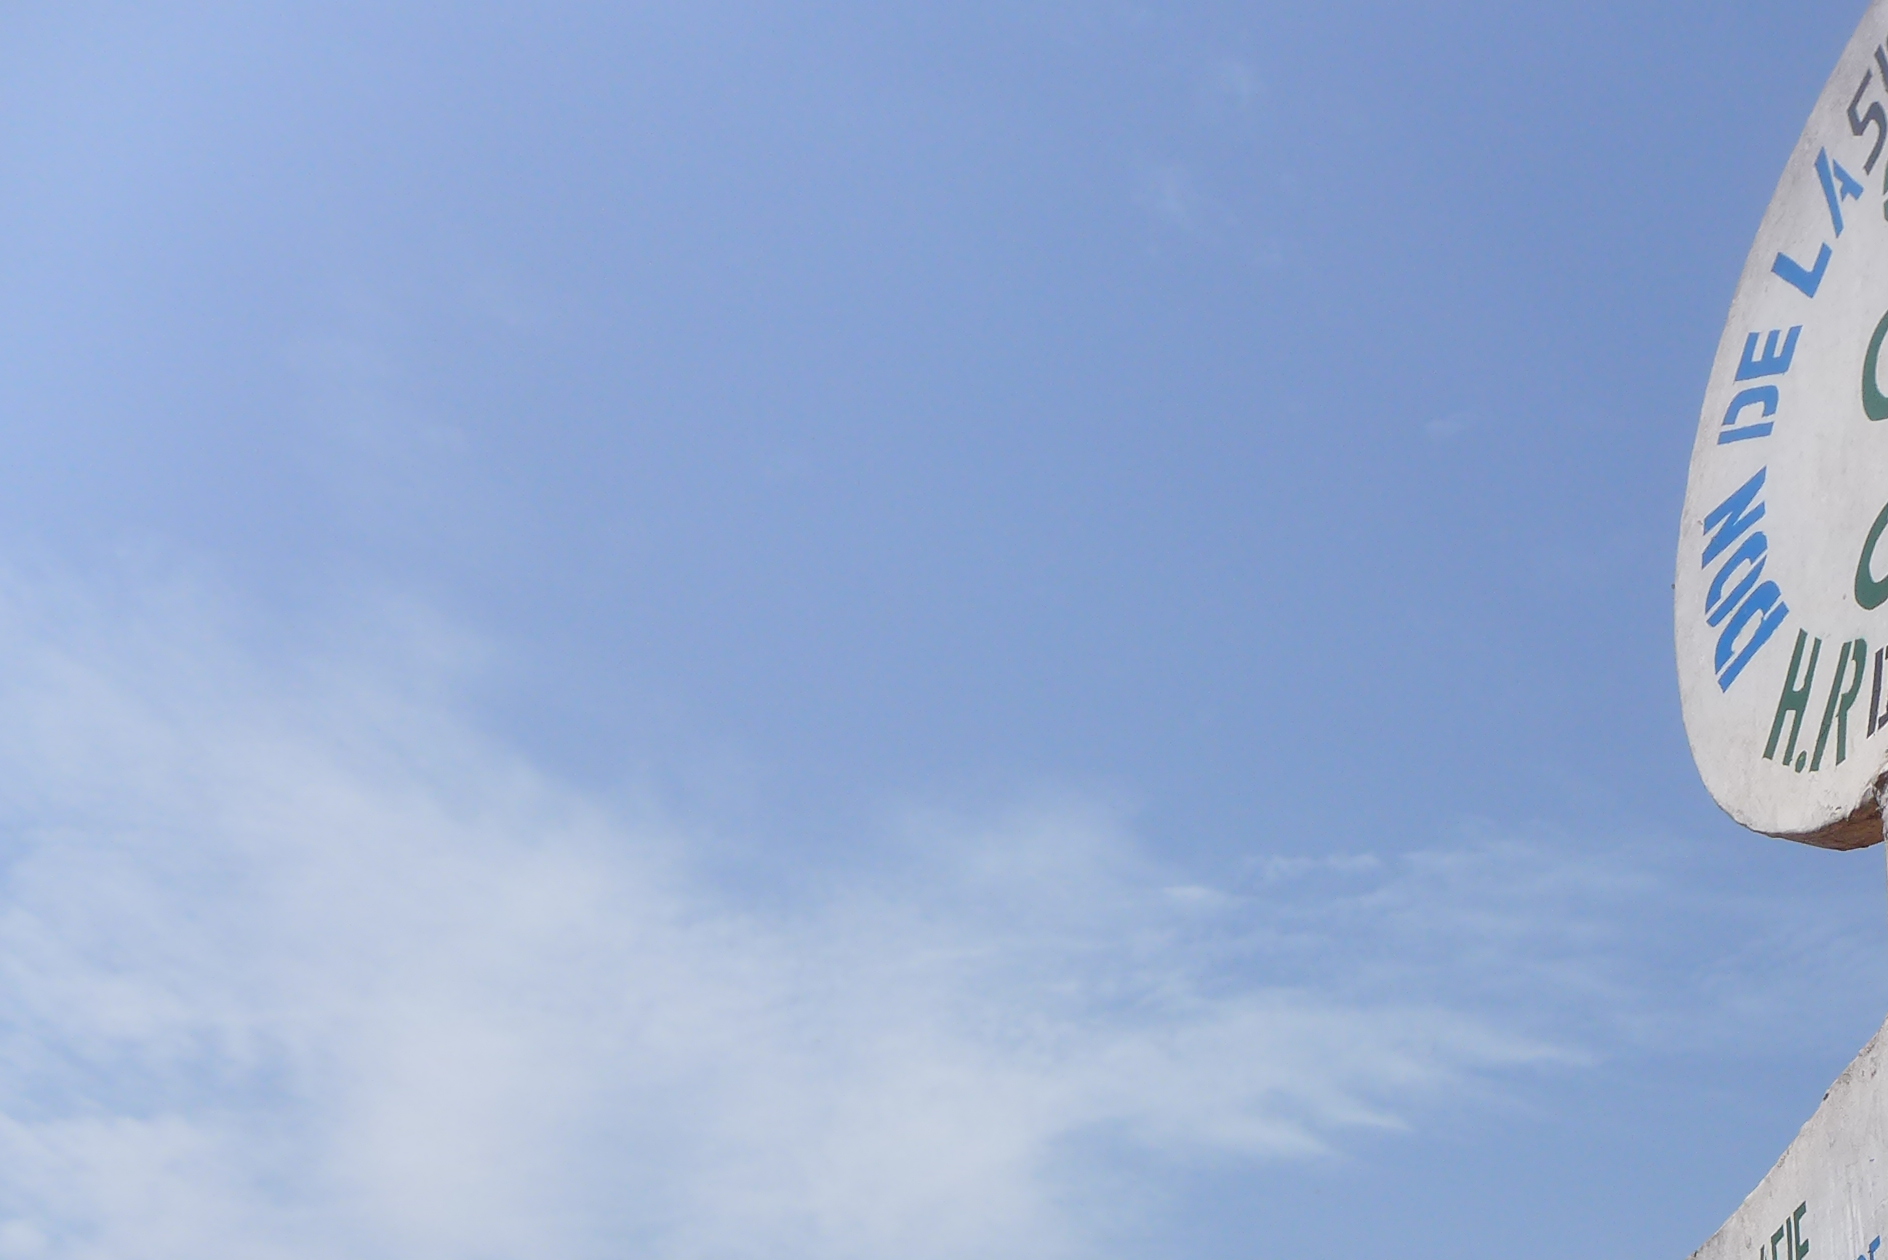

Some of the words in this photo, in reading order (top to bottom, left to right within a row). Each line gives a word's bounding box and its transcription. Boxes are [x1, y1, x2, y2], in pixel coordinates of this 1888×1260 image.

[1771, 145, 1864, 298] LA
[1718, 324, 1803, 445] DE
[1702, 465, 1789, 693] DON
